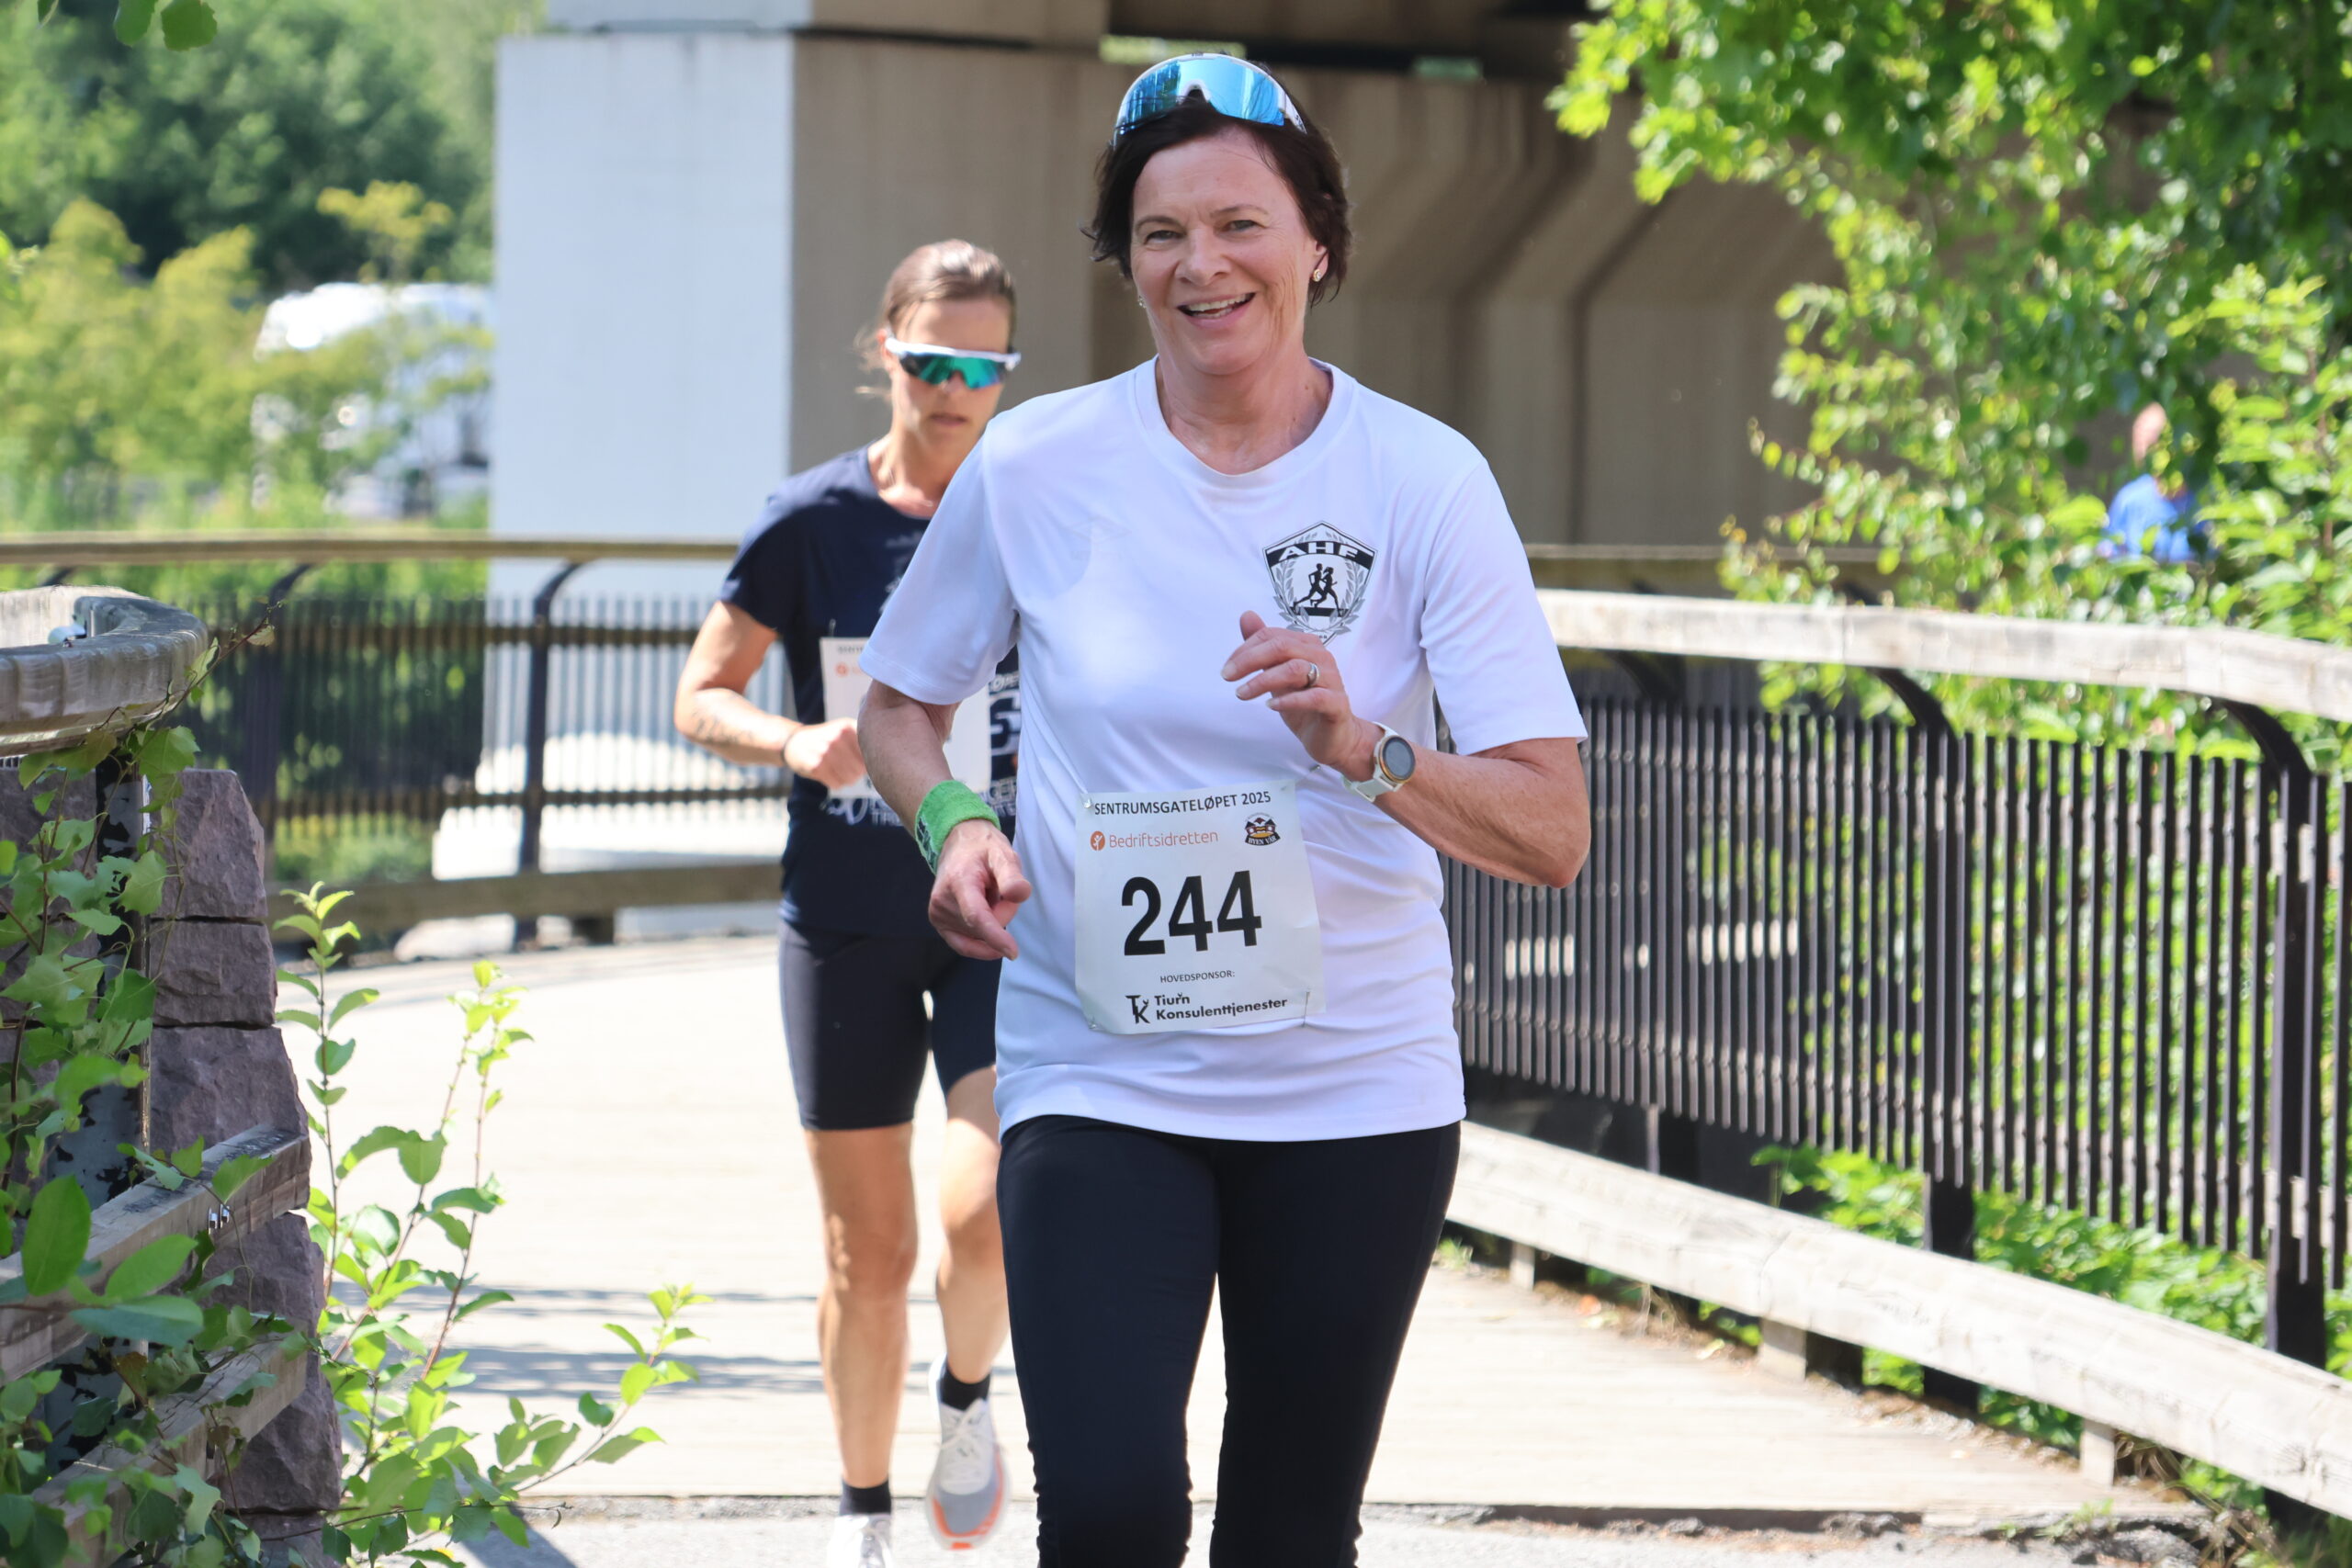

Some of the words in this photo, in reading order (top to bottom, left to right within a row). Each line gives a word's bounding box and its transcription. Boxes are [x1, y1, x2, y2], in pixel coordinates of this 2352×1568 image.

[1094, 795, 1238, 816] SENTRUMSGATELØPET
[1241, 791, 1272, 806] 2025
[1109, 831, 1218, 848] Bedriftsidretten
[1121, 870, 1262, 956] 244
[1159, 970, 1236, 983] HOVEDSPONSOR:
[1156, 999, 1288, 1021] Konsulenttjenester
